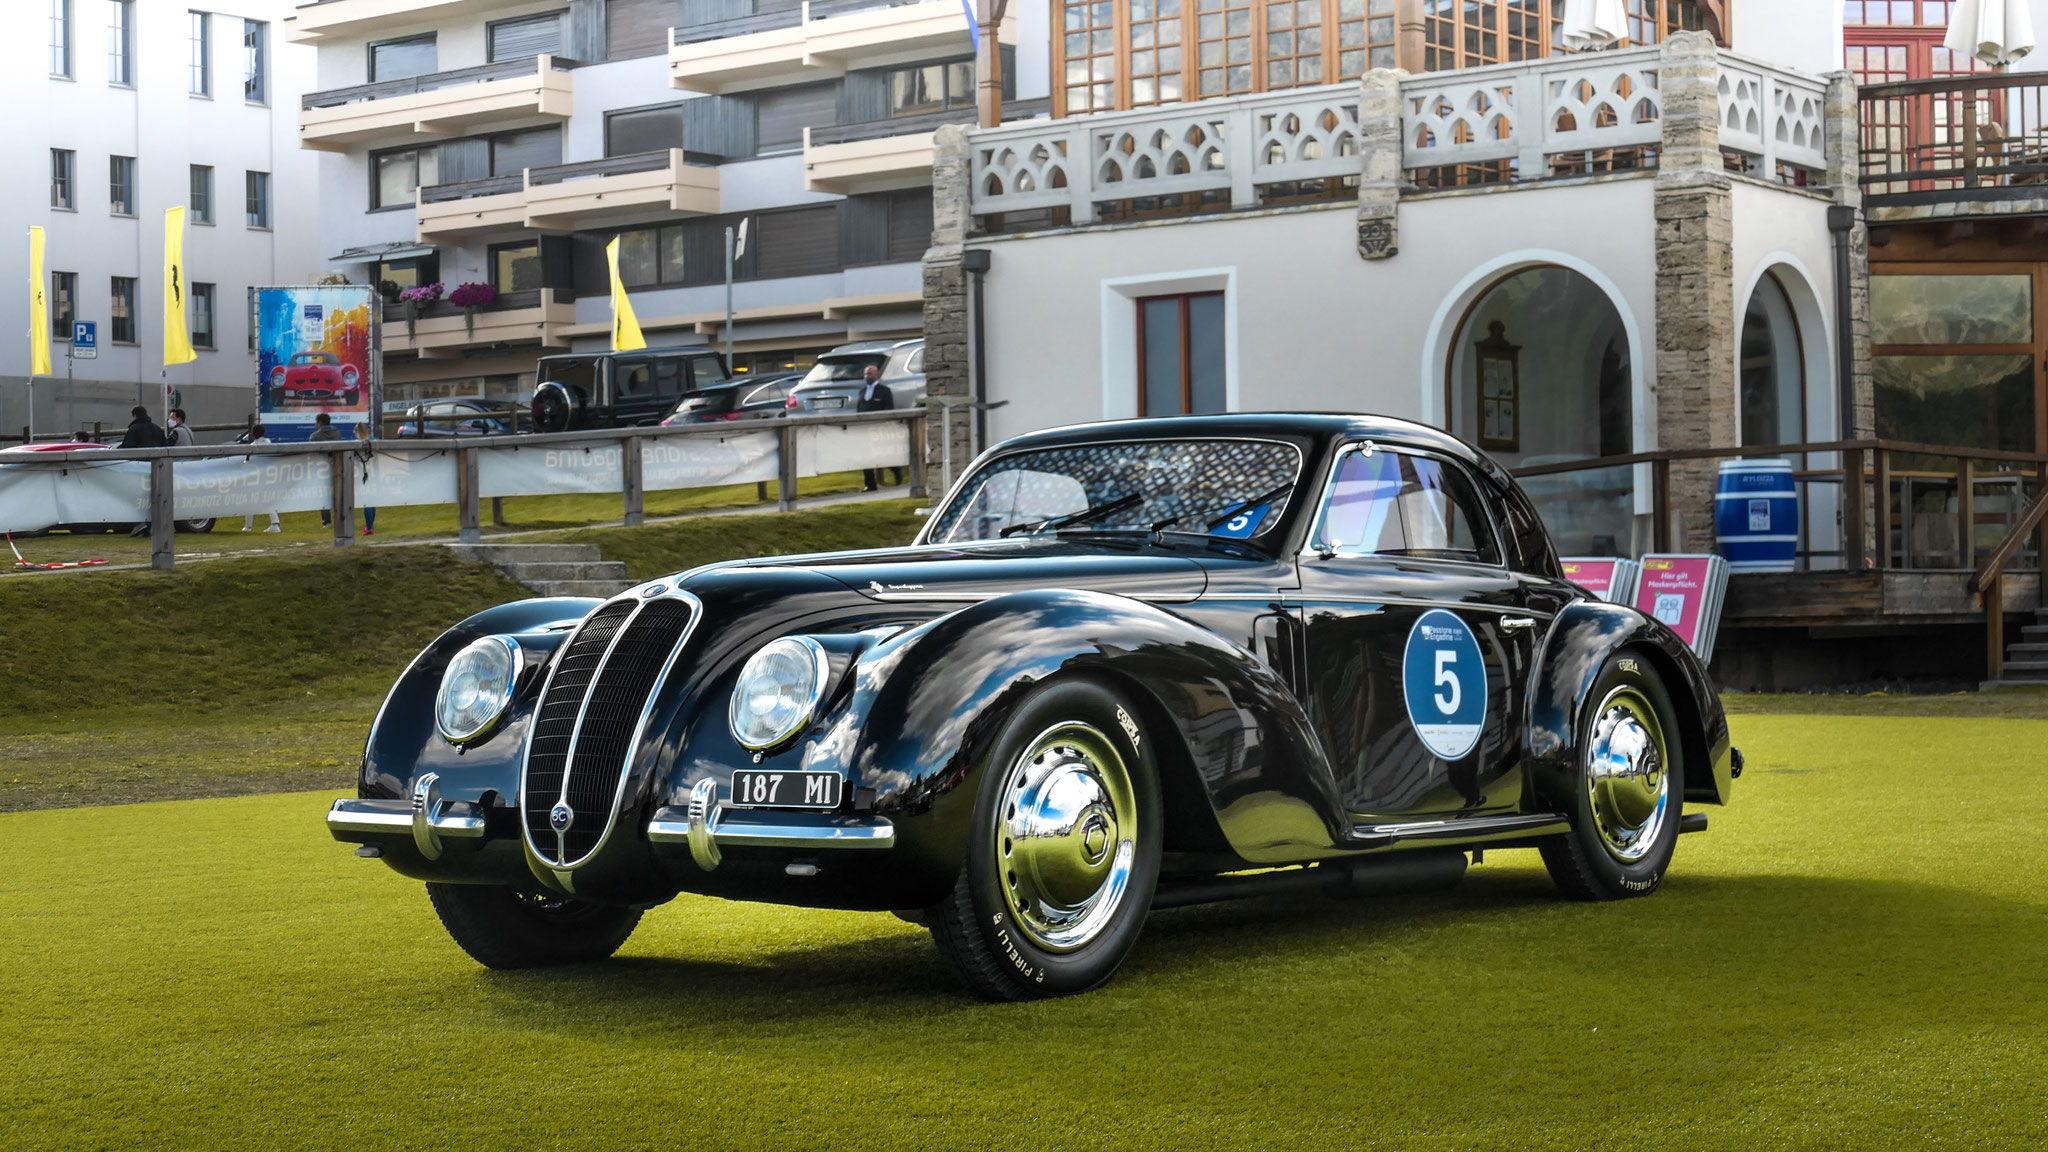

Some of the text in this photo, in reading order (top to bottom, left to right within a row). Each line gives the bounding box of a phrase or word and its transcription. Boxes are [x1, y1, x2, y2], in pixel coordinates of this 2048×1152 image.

[76, 324, 87, 342] P
[1227, 510, 1254, 531] 5
[1647, 580, 1698, 589] Maskenpflicht.
[1660, 572, 1688, 581] Hier gilt
[1434, 650, 1461, 715] 5
[742, 774, 833, 804] 187 MI
[552, 810, 567, 822] 6C
[997, 929, 1034, 977] PIRELLI
